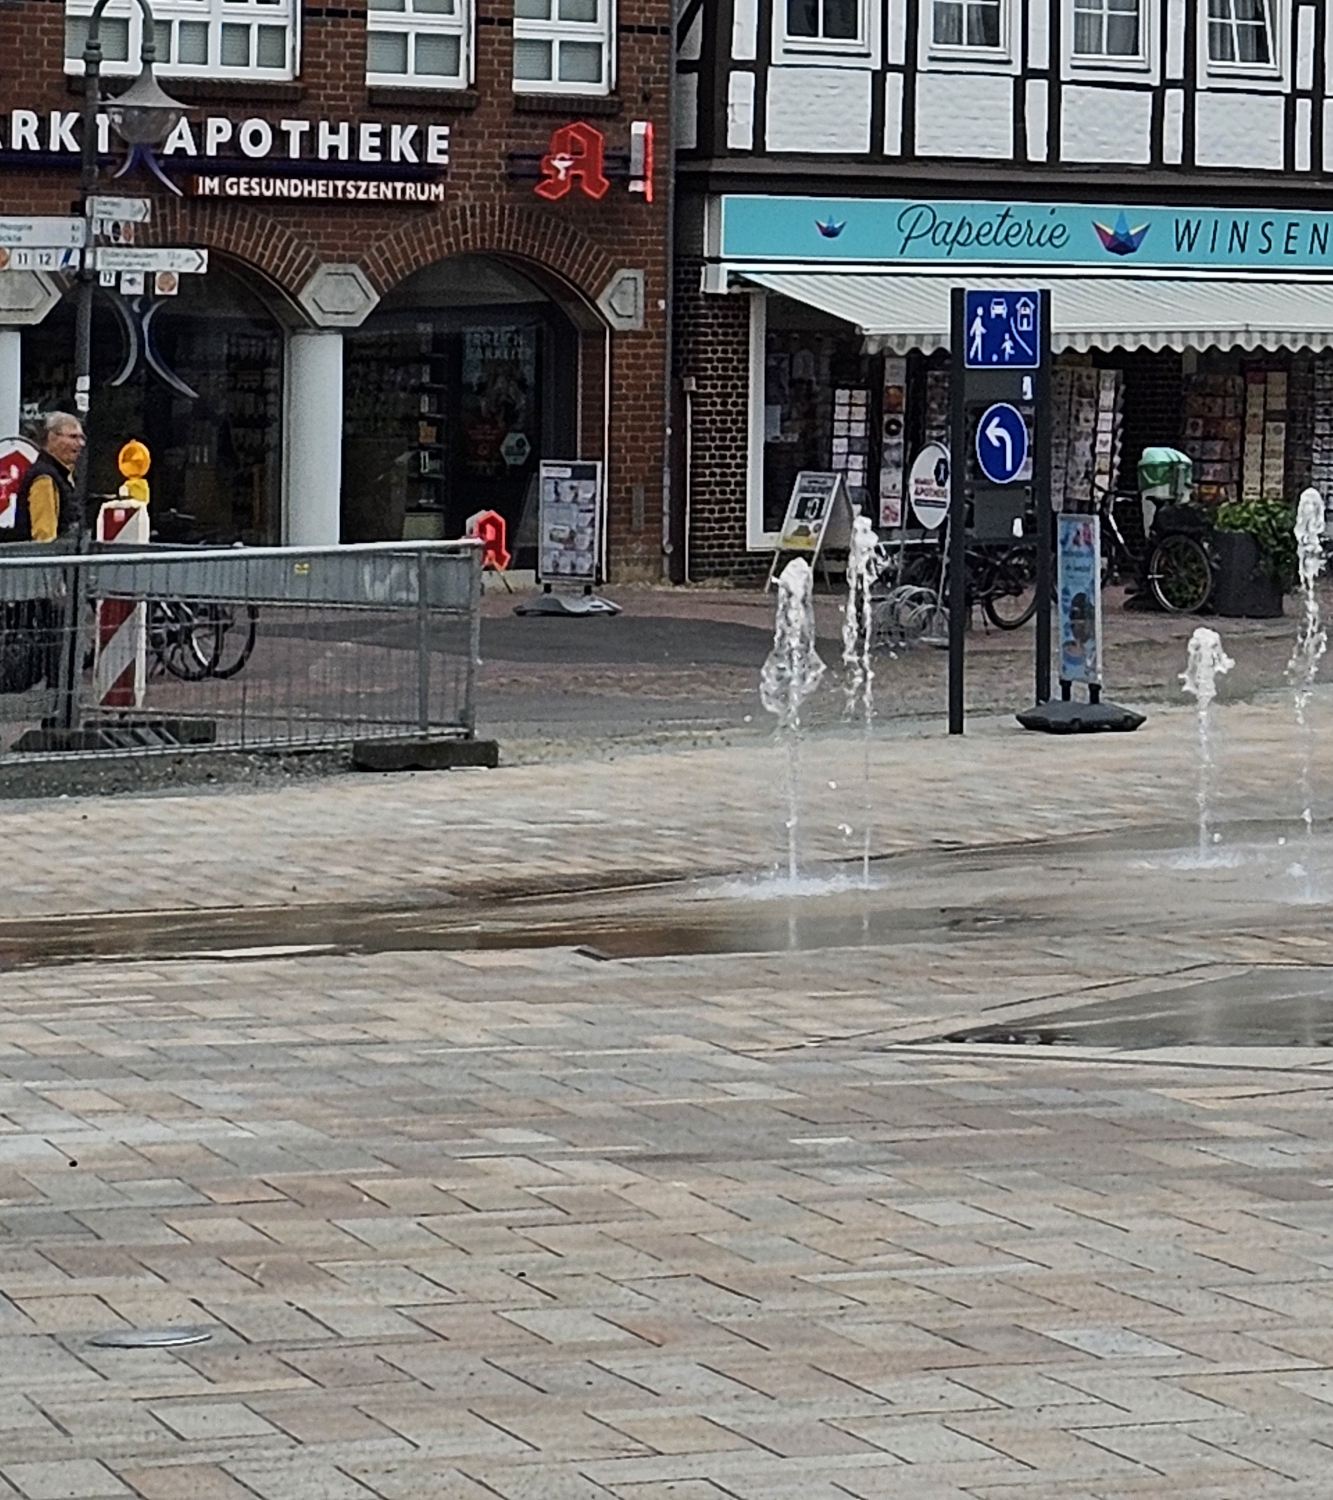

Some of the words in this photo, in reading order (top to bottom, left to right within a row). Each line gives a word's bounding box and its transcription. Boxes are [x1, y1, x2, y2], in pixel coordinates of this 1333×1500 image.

[163, 116, 450, 165] APOTHEKE
[198, 176, 220, 195] IM
[225, 177, 445, 202] GESUNDHEITSZENTRUM
[897, 204, 1070, 257] Papeterie
[1173, 218, 1330, 255] WINSEN
